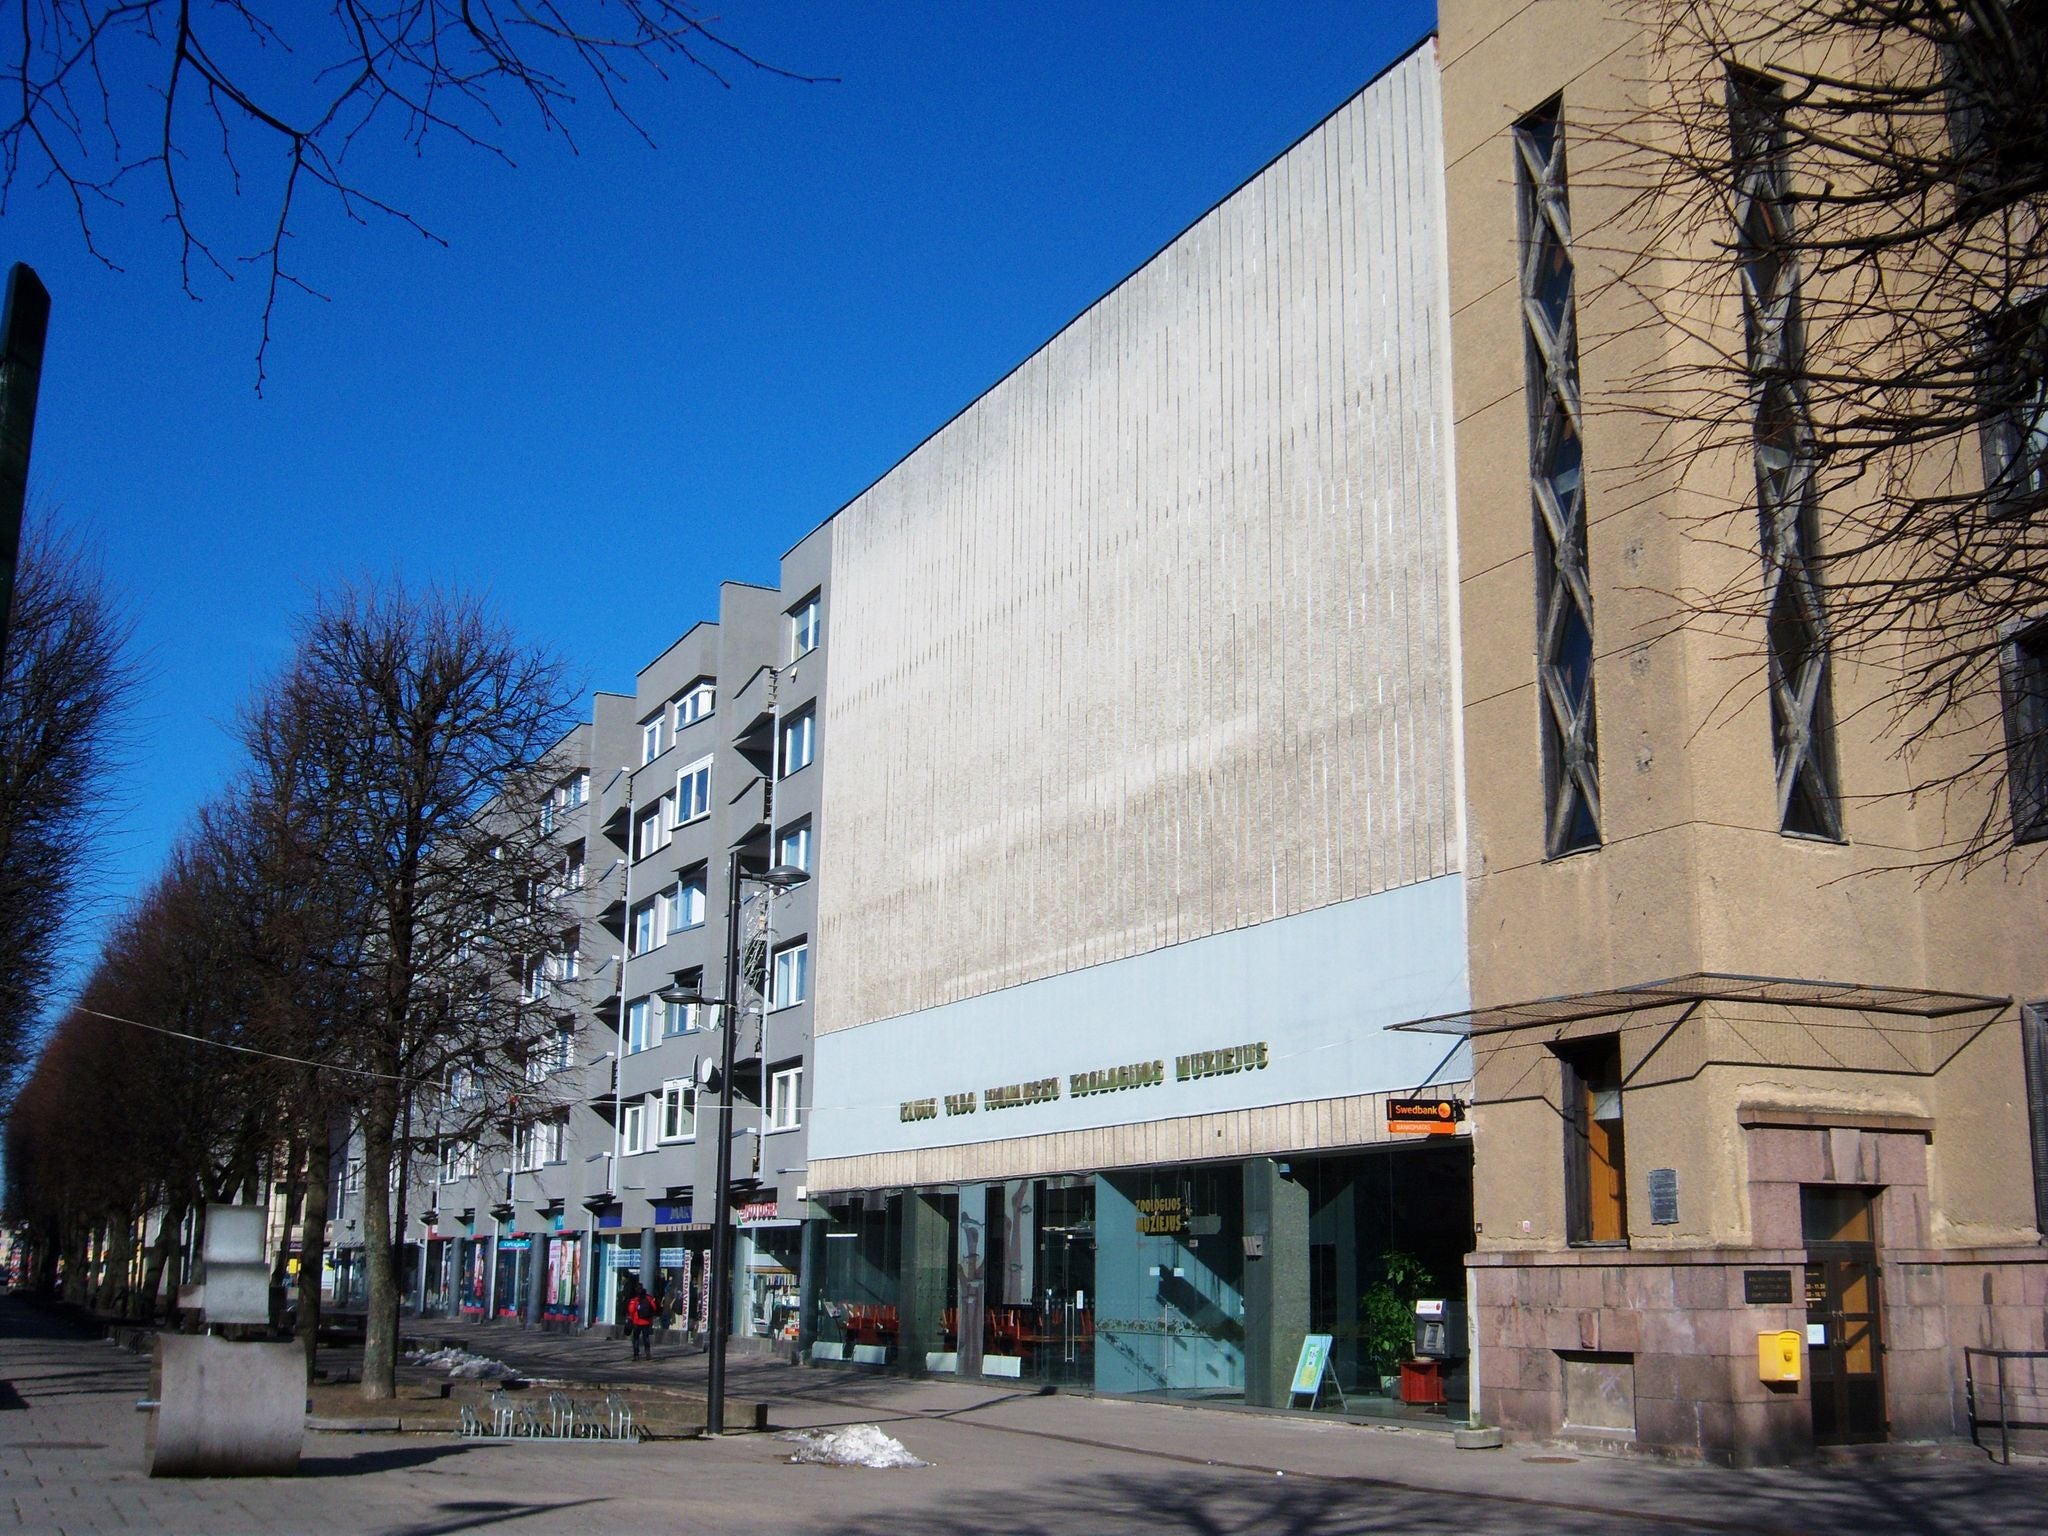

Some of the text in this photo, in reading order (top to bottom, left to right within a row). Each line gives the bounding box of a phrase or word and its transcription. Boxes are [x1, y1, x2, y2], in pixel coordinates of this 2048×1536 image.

[1070, 1059, 1165, 1099] ZOOLOGIJOS
[1175, 1041, 1269, 1083] MUZIEJUS
[1395, 1105, 1437, 1115] Swedbank
[1135, 1197, 1181, 1212] ZOOLOGIJOS
[1135, 1214, 1181, 1233] MUZIEJUS
